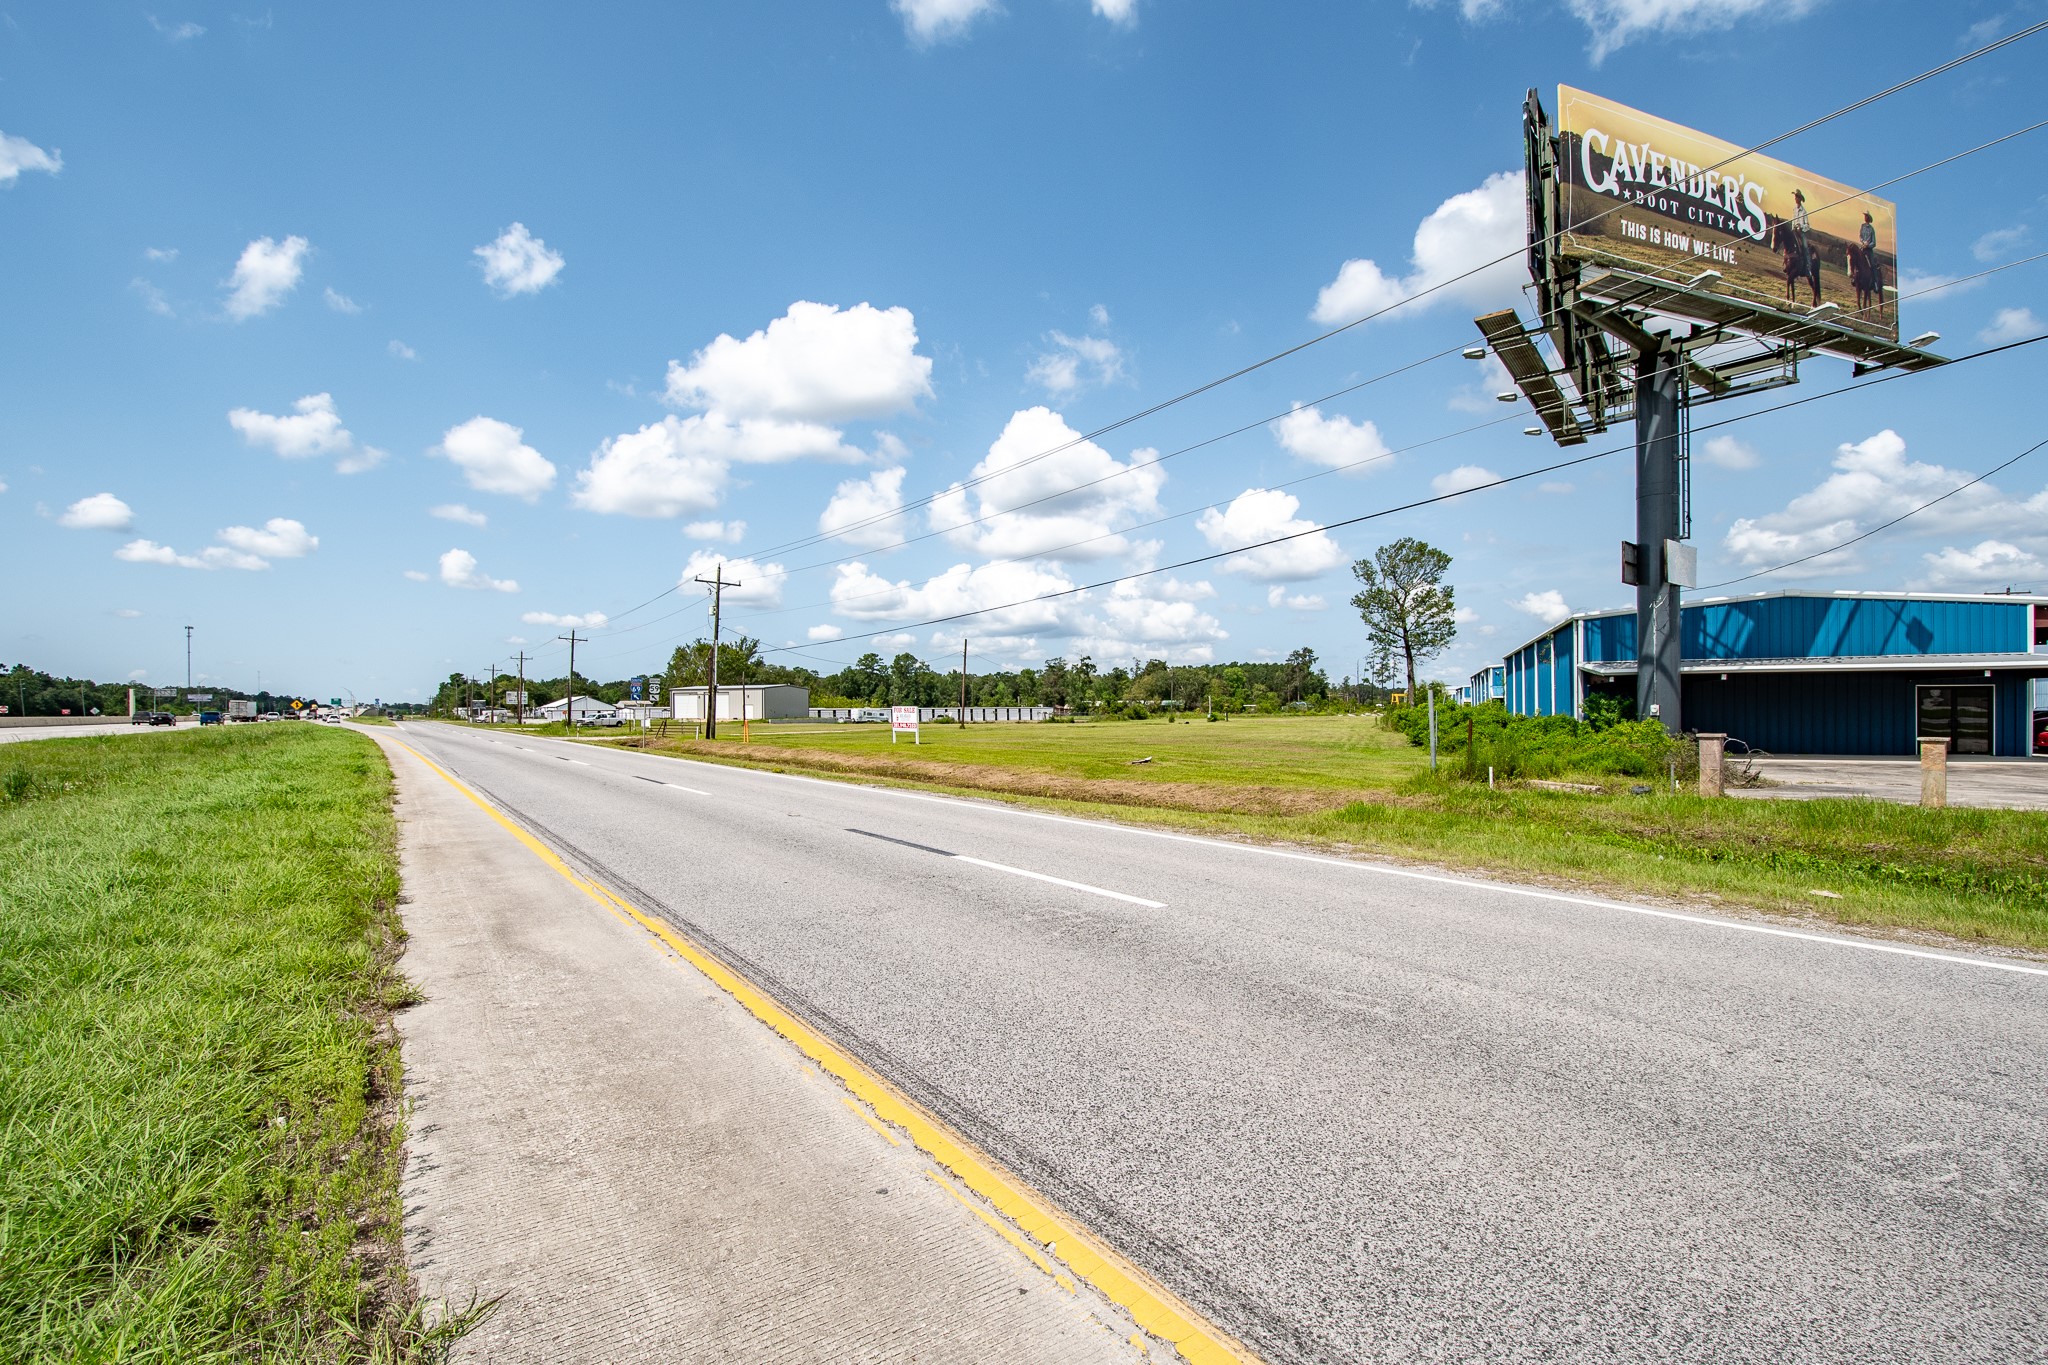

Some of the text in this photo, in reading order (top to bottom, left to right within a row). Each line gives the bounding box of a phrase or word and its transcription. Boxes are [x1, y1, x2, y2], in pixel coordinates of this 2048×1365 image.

[1581, 128, 1766, 240] CAVENDER'S
[1635, 190, 1725, 228] BOOT CITY
[1621, 220, 1737, 265] THIS IS HOW WE LIVE.
